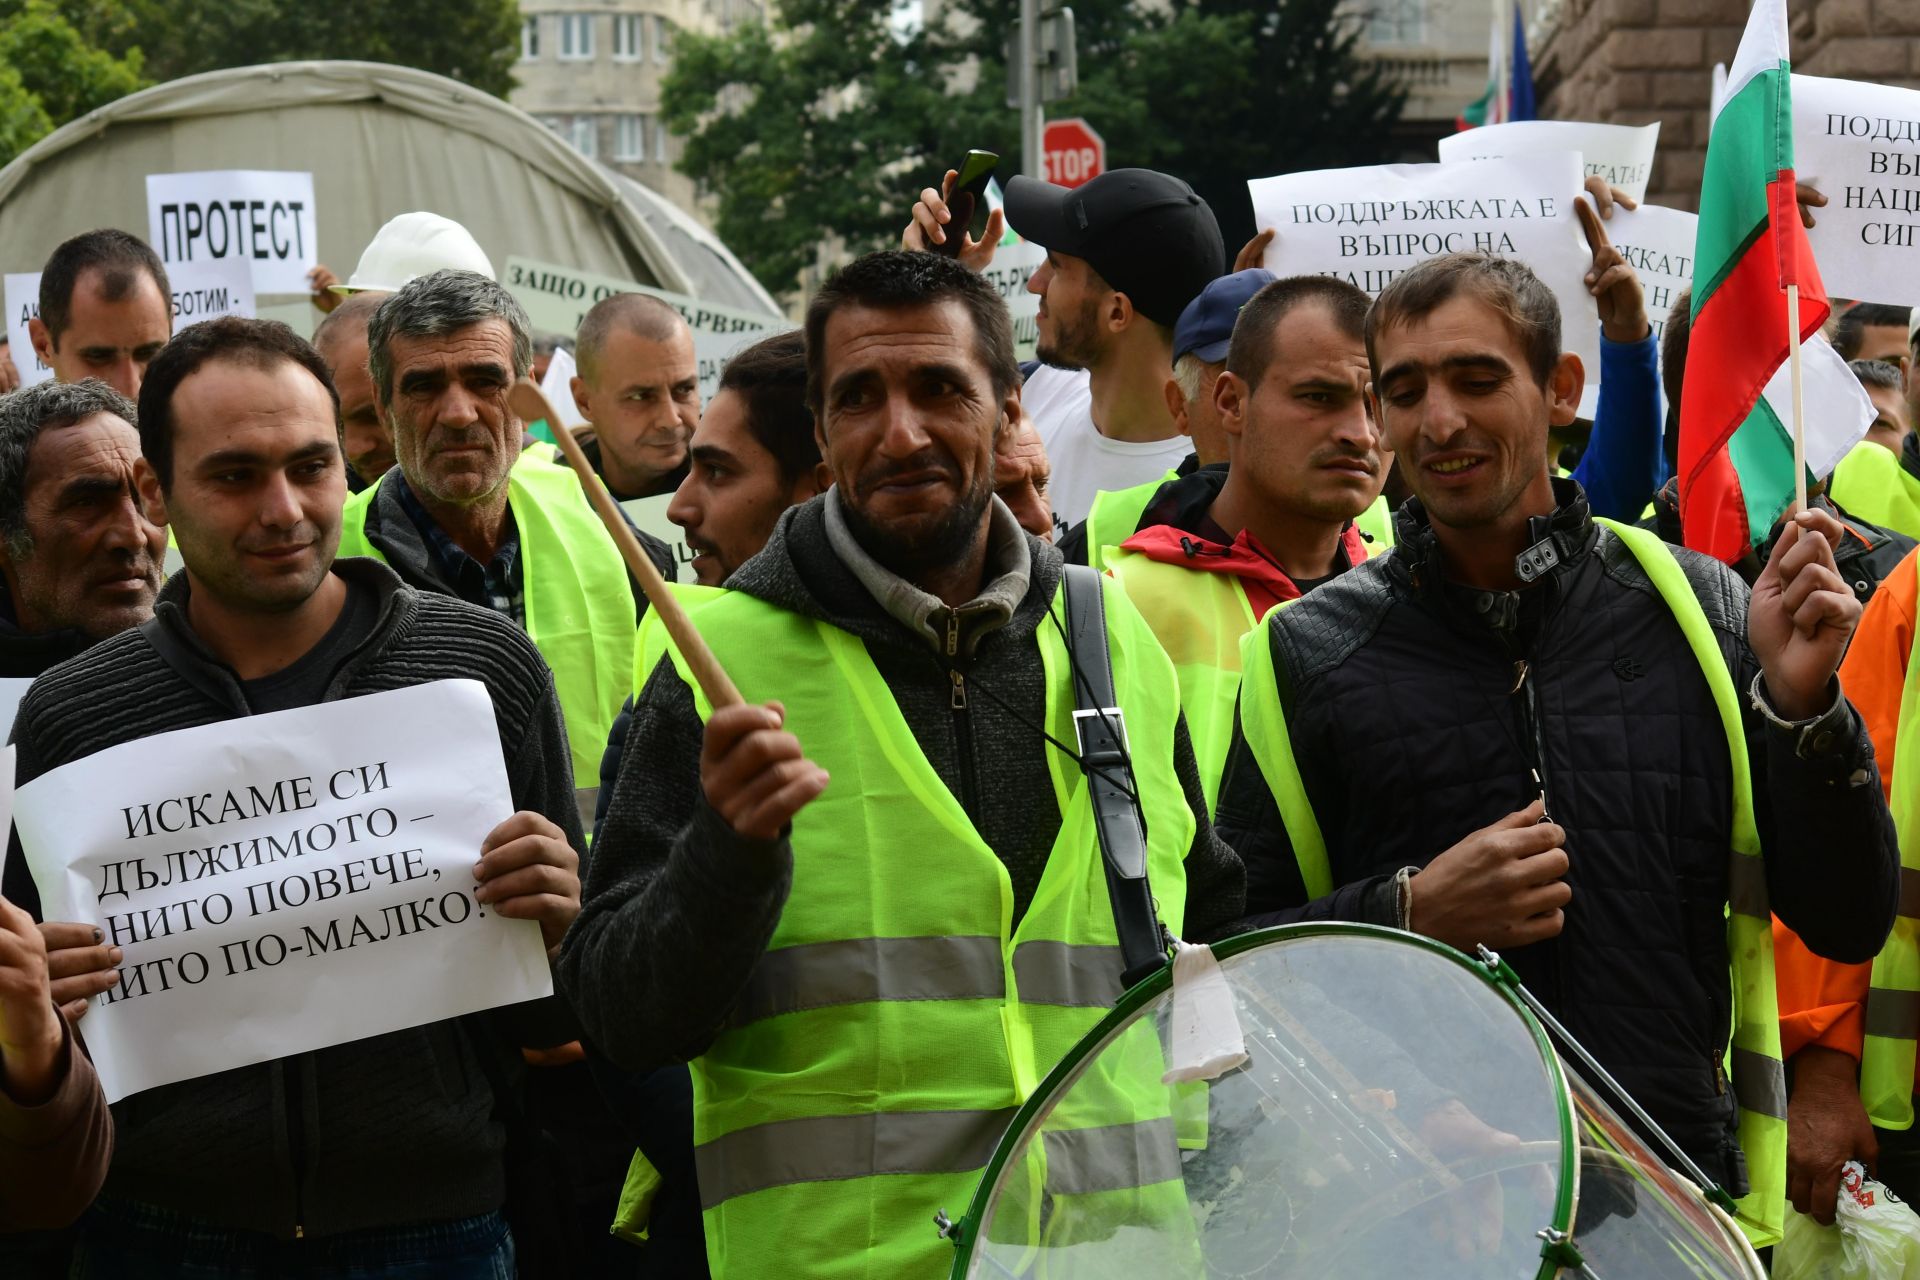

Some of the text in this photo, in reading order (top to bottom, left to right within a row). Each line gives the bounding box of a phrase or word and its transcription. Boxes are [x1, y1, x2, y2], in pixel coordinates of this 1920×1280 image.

[1826, 113, 1920, 145] ПОДД
[1291, 198, 1557, 227] ПОДДРЪЖКАТА Е
[161, 200, 304, 262] ПРОТЕСТ
[1339, 231, 1517, 257] ВЪПРОС НА
[1616, 245, 1693, 279] ЖКАТ
[509, 264, 586, 300] ЗАЩО
[120, 761, 392, 839] ИСКАМЕ СИ
[97, 807, 398, 905] ДЪЛЖИМОТО
[106, 848, 441, 947] НИТО ПОВЕЧЕ,
